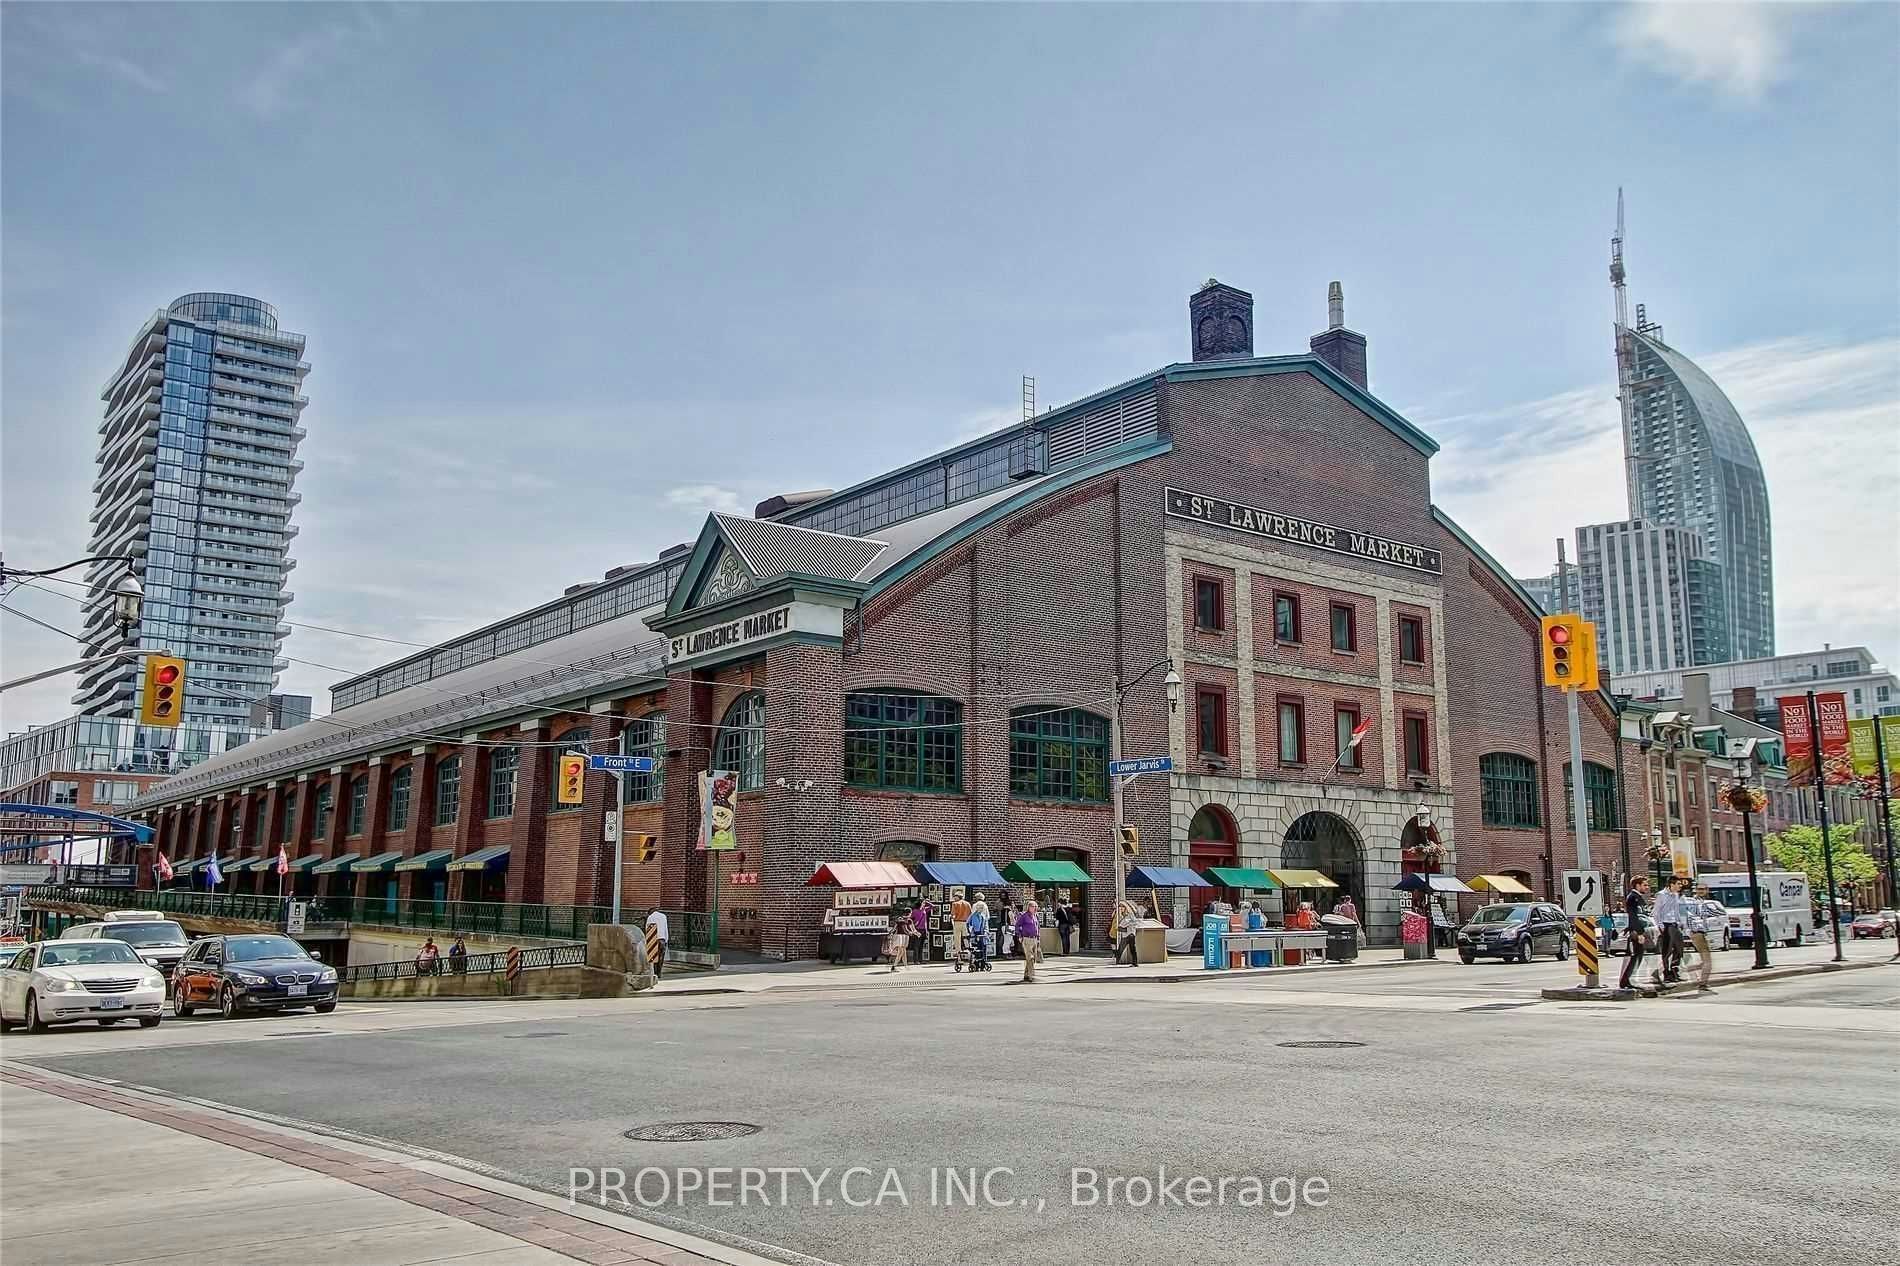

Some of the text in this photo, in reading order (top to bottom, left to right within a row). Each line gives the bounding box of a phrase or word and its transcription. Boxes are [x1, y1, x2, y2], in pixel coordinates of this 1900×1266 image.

[1229, 505, 1336, 547] LAWRENCE
[1350, 533, 1424, 567] MARKET
[686, 622, 740, 656] LAWRENCE
[743, 607, 790, 640] MARKET
[604, 757, 627, 768] Front
[635, 758, 640, 768] E
[1117, 761, 1137, 771] Lower
[1138, 759, 1159, 770] Jarvis
[1780, 881, 1803, 897] Canpar
